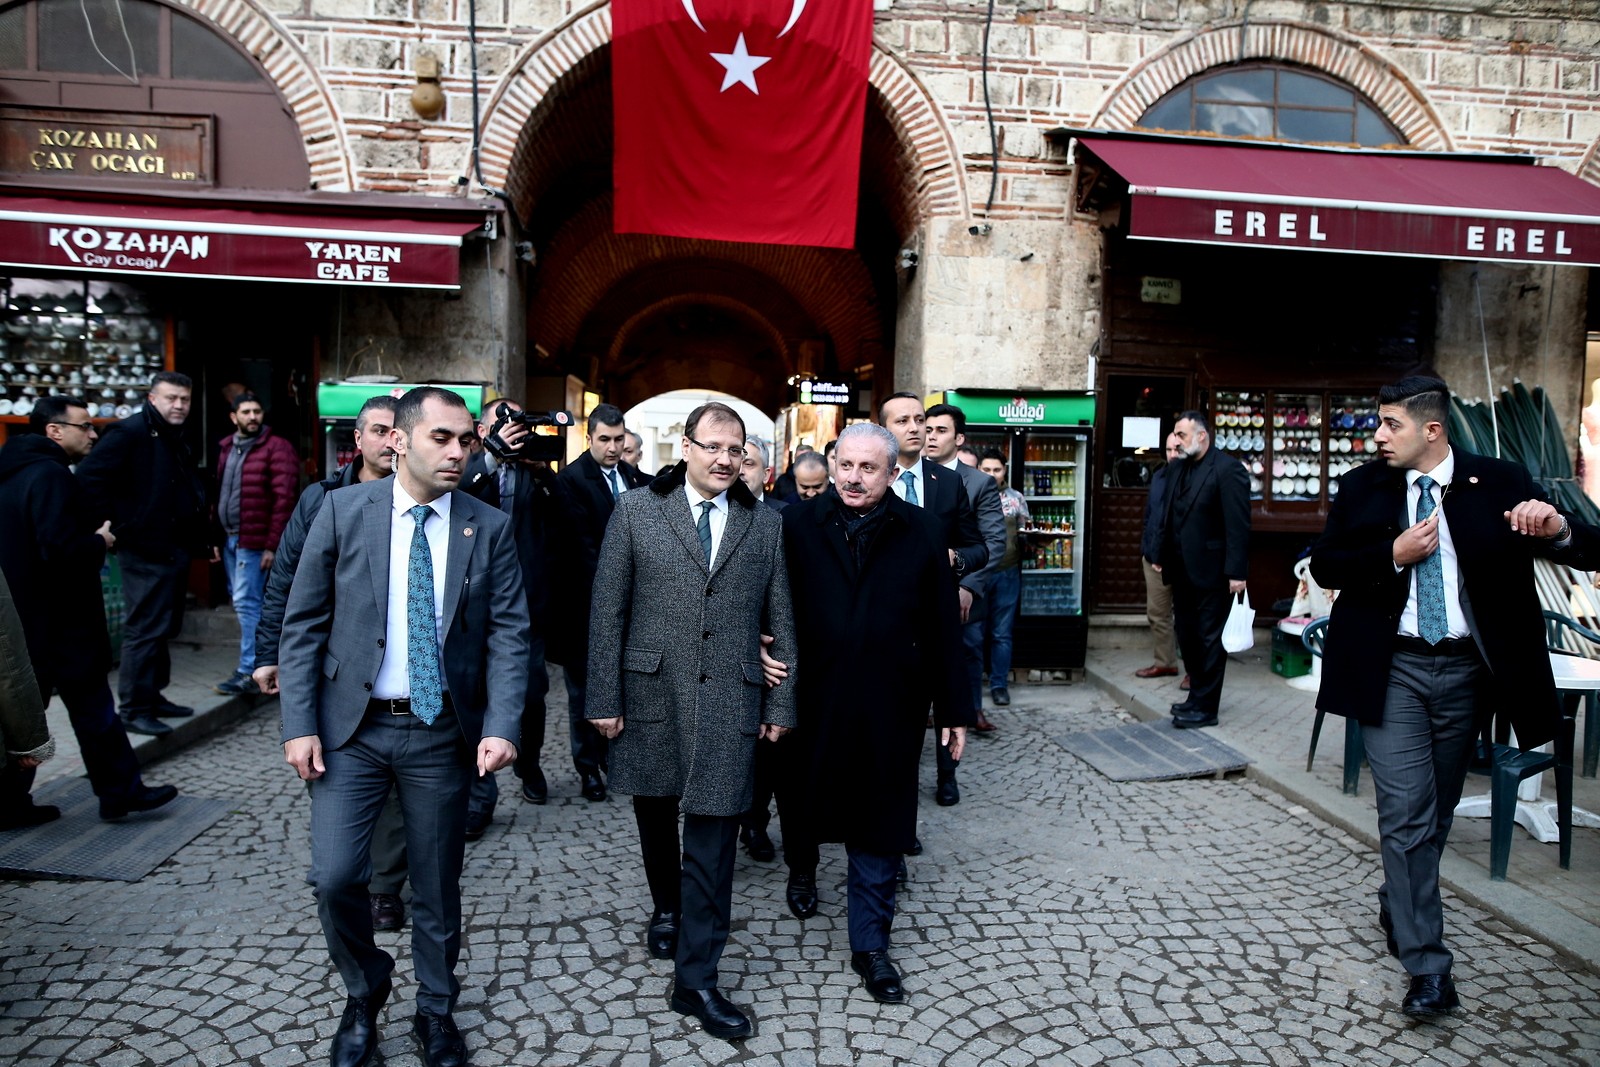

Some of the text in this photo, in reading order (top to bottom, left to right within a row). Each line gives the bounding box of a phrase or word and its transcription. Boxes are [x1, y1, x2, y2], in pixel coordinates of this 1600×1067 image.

[38, 128, 158, 151] KOZAHAN
[29, 151, 76, 171] ÇAY
[1214, 209, 1327, 241] EREL
[48, 227, 209, 269] KOZAHAN
[1466, 225, 1573, 255] EREL
[83, 252, 158, 270] Çay Ocağı
[305, 241, 401, 263] YAREN
[317, 262, 390, 282] CAFE
[999, 403, 1045, 421] uludağ
